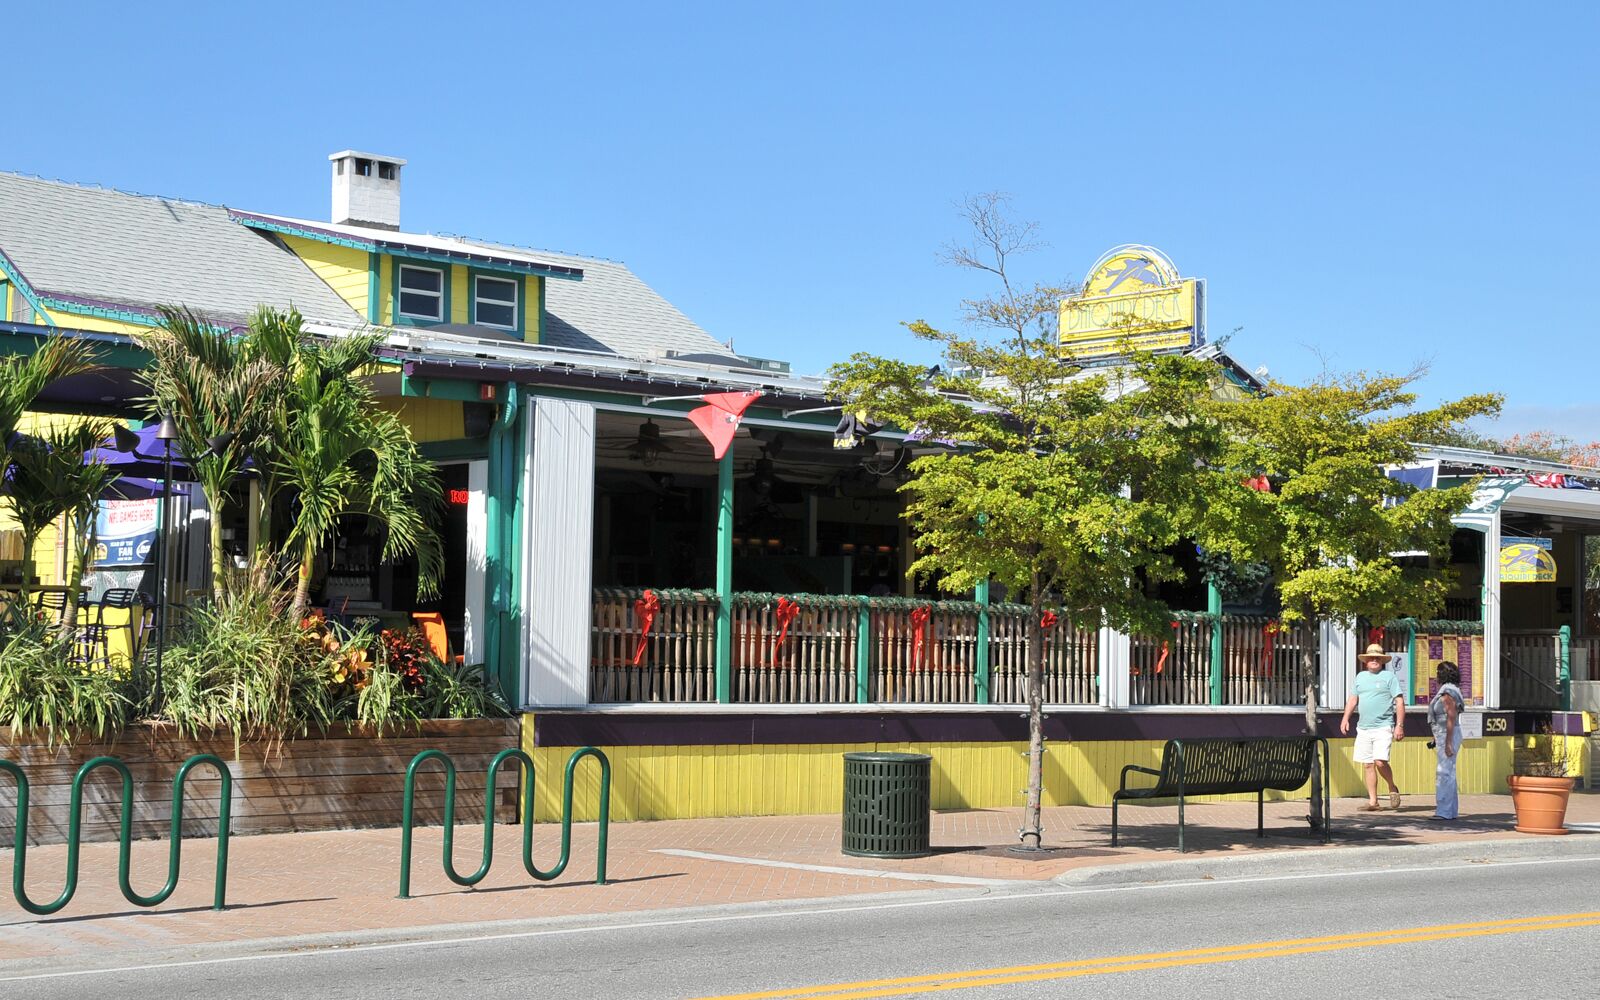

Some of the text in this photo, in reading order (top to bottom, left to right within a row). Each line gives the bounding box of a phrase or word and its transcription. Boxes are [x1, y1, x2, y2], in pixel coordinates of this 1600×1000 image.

[1143, 294, 1181, 321] DECK
[119, 510, 138, 523] GAMES
[139, 509, 154, 521] HERE
[119, 547, 133, 557] FAN
[1486, 718, 1507, 732] 5250
